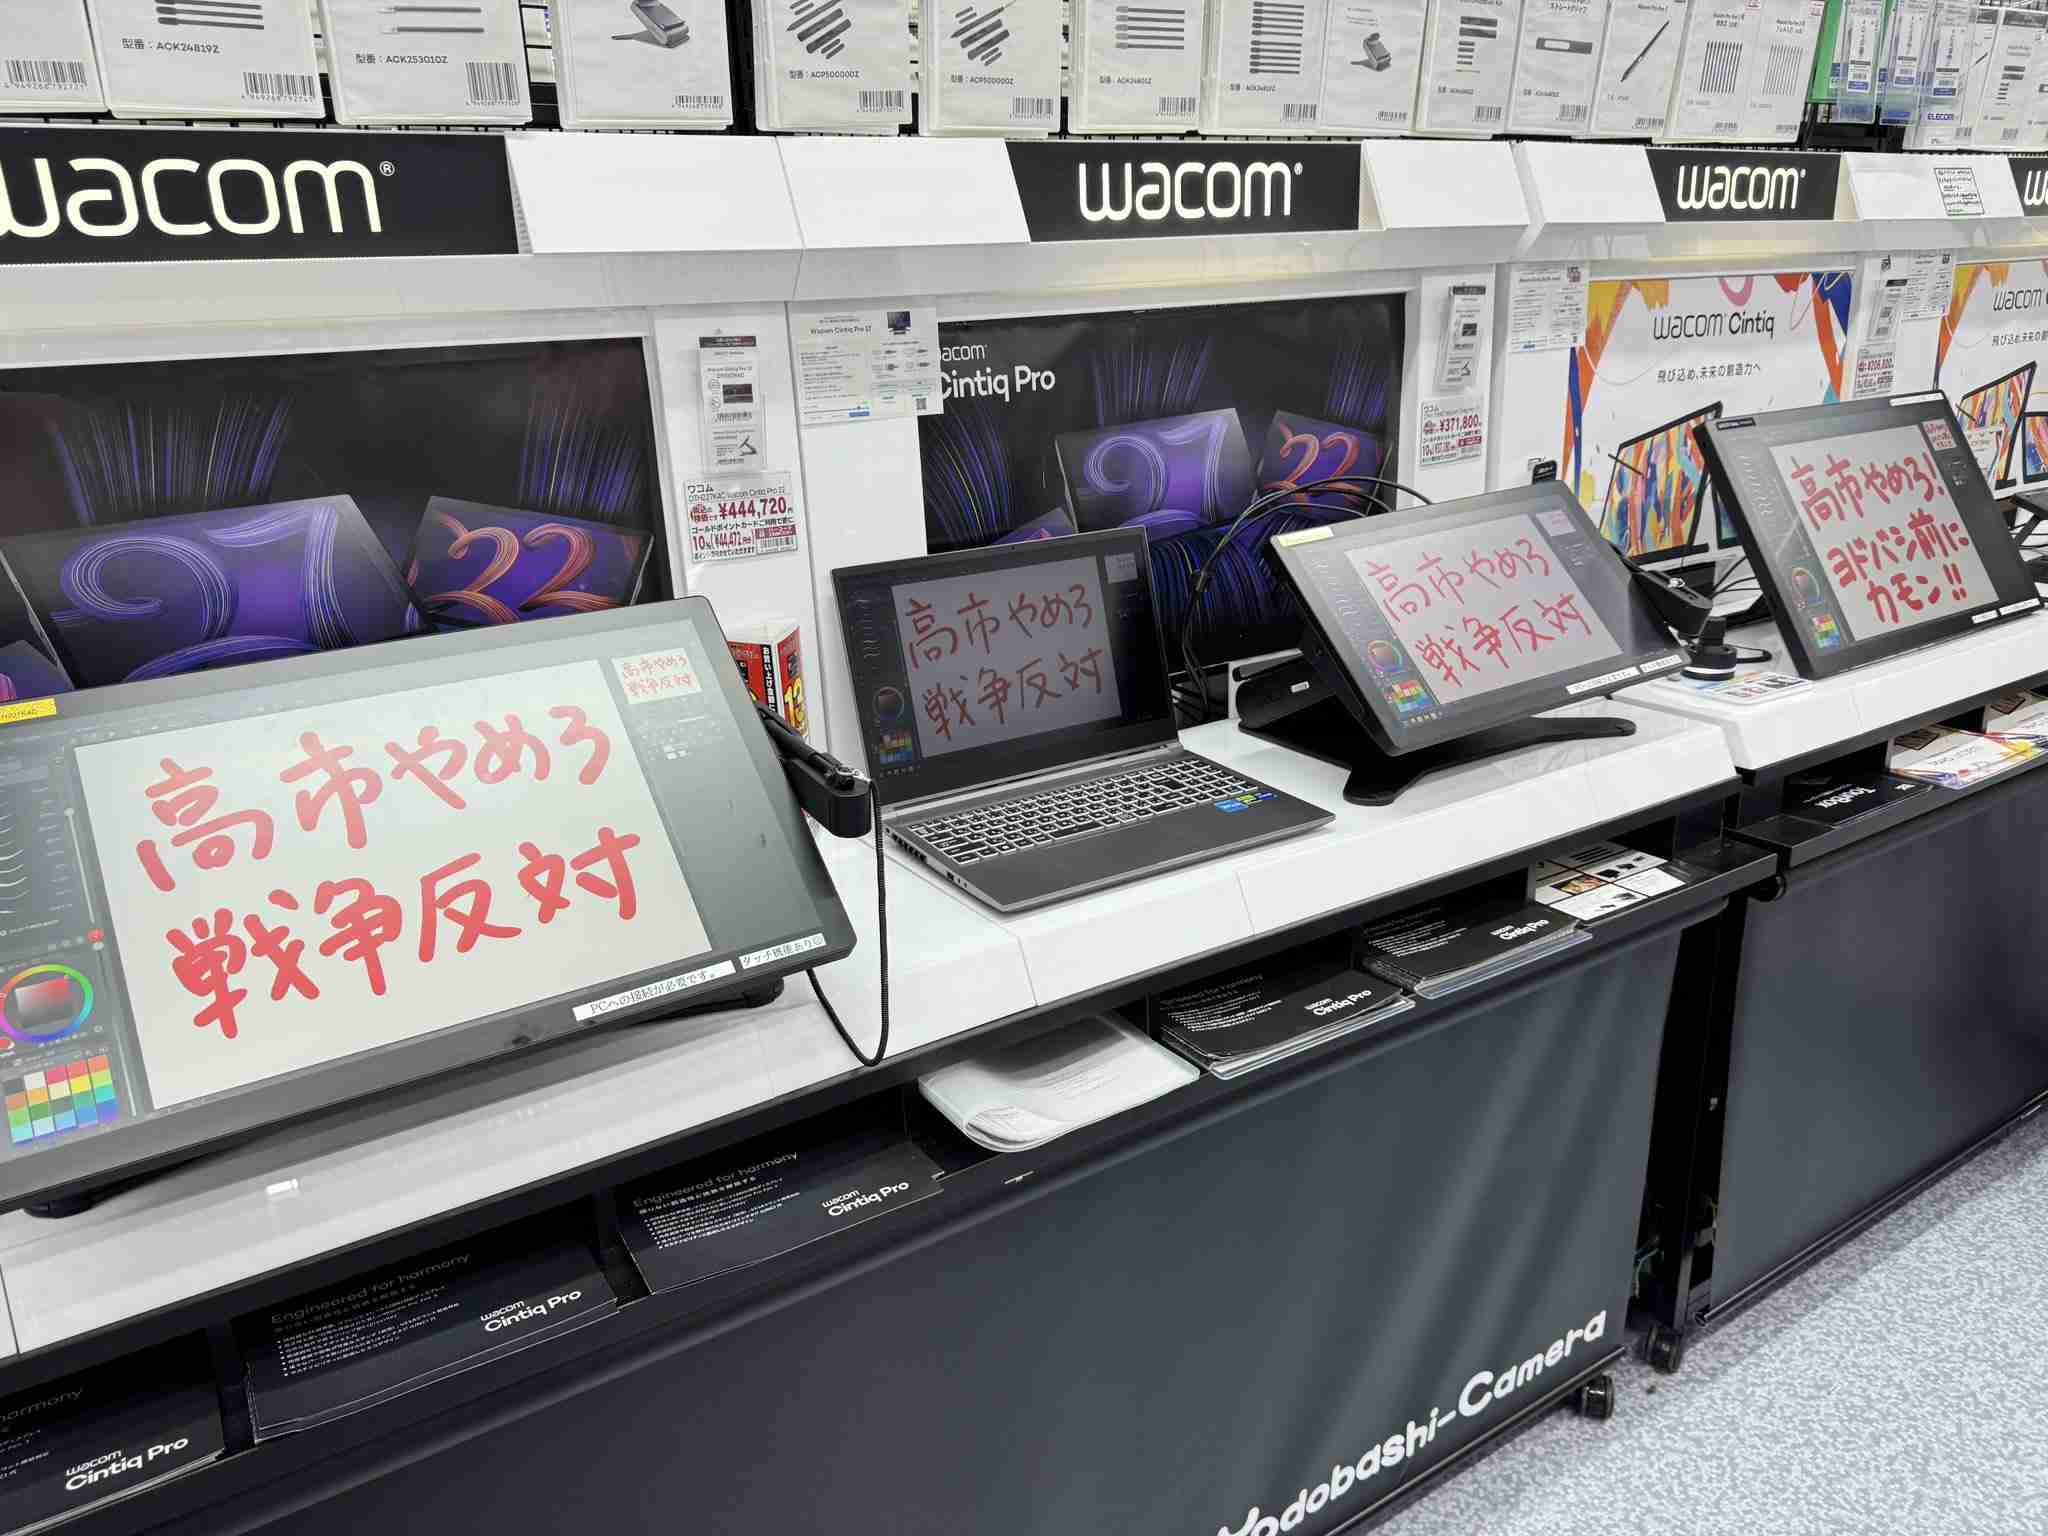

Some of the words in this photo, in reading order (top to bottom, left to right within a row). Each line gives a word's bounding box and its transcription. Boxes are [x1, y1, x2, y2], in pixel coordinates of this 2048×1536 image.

[1728, 309, 1775, 340] Cintiq
[940, 344, 986, 362] acom
[941, 367, 1010, 402] Cintiq
[1014, 364, 1056, 393] Pro
[687, 483, 714, 494] ワコム
[1365, 538, 1551, 622] 高市やめろ
[905, 582, 1094, 670] 高市やめろ
[1415, 593, 1593, 688] 戦争反対
[921, 646, 1105, 741] 戦争反対
[136, 705, 612, 892] 高市やめろ
[165, 825, 641, 1039] 戦争反対
[1347, 989, 1372, 1002] Pro
[714, 1170, 737, 1185] for
[738, 1151, 799, 1177] harmony
[827, 1192, 883, 1217] Cintiq
[880, 1181, 910, 1199] Pro
[270, 1284, 368, 1325] Engineered
[368, 1276, 396, 1296] for
[397, 1253, 472, 1286] harmony
[484, 1304, 548, 1332] Cintiq
[547, 1289, 583, 1310] Pro
[64, 1454, 144, 1491] Cintiq
[147, 1437, 189, 1461] Pro
